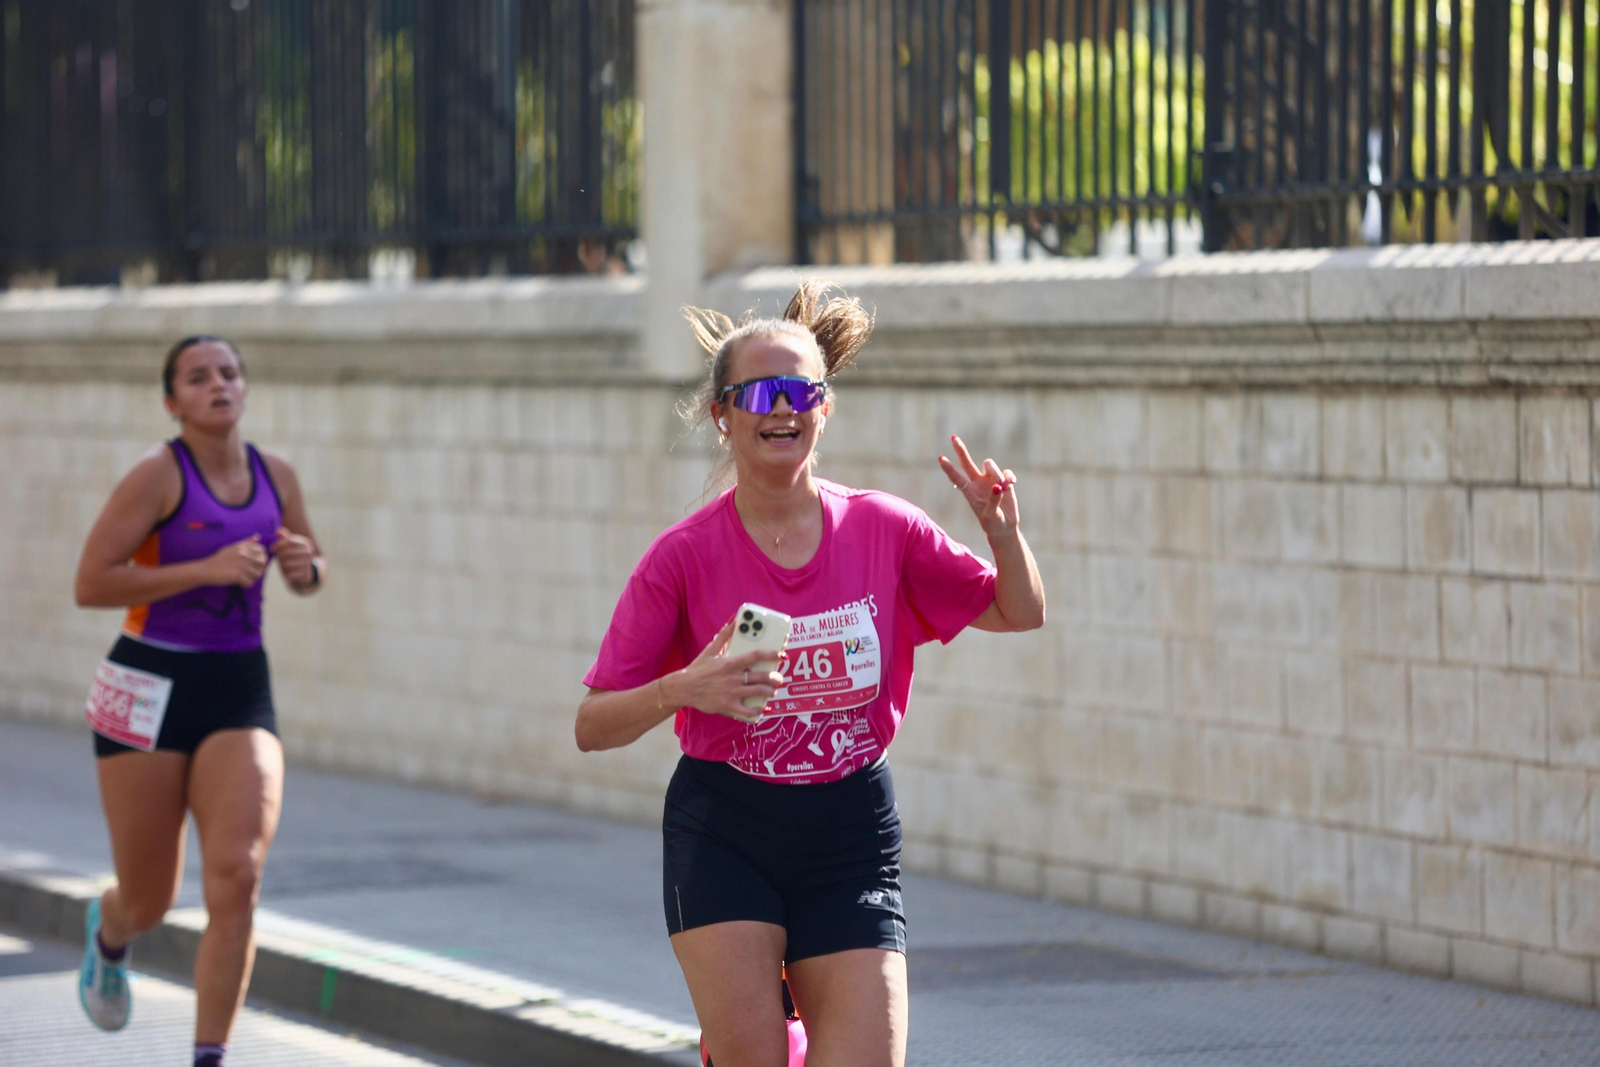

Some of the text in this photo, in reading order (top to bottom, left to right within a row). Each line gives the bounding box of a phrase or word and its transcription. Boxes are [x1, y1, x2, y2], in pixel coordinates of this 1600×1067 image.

[790, 621, 807, 636] RA
[818, 612, 859, 632] MUJERES
[809, 683, 826, 691] CONTRA
[786, 760, 814, 773] #porellas
